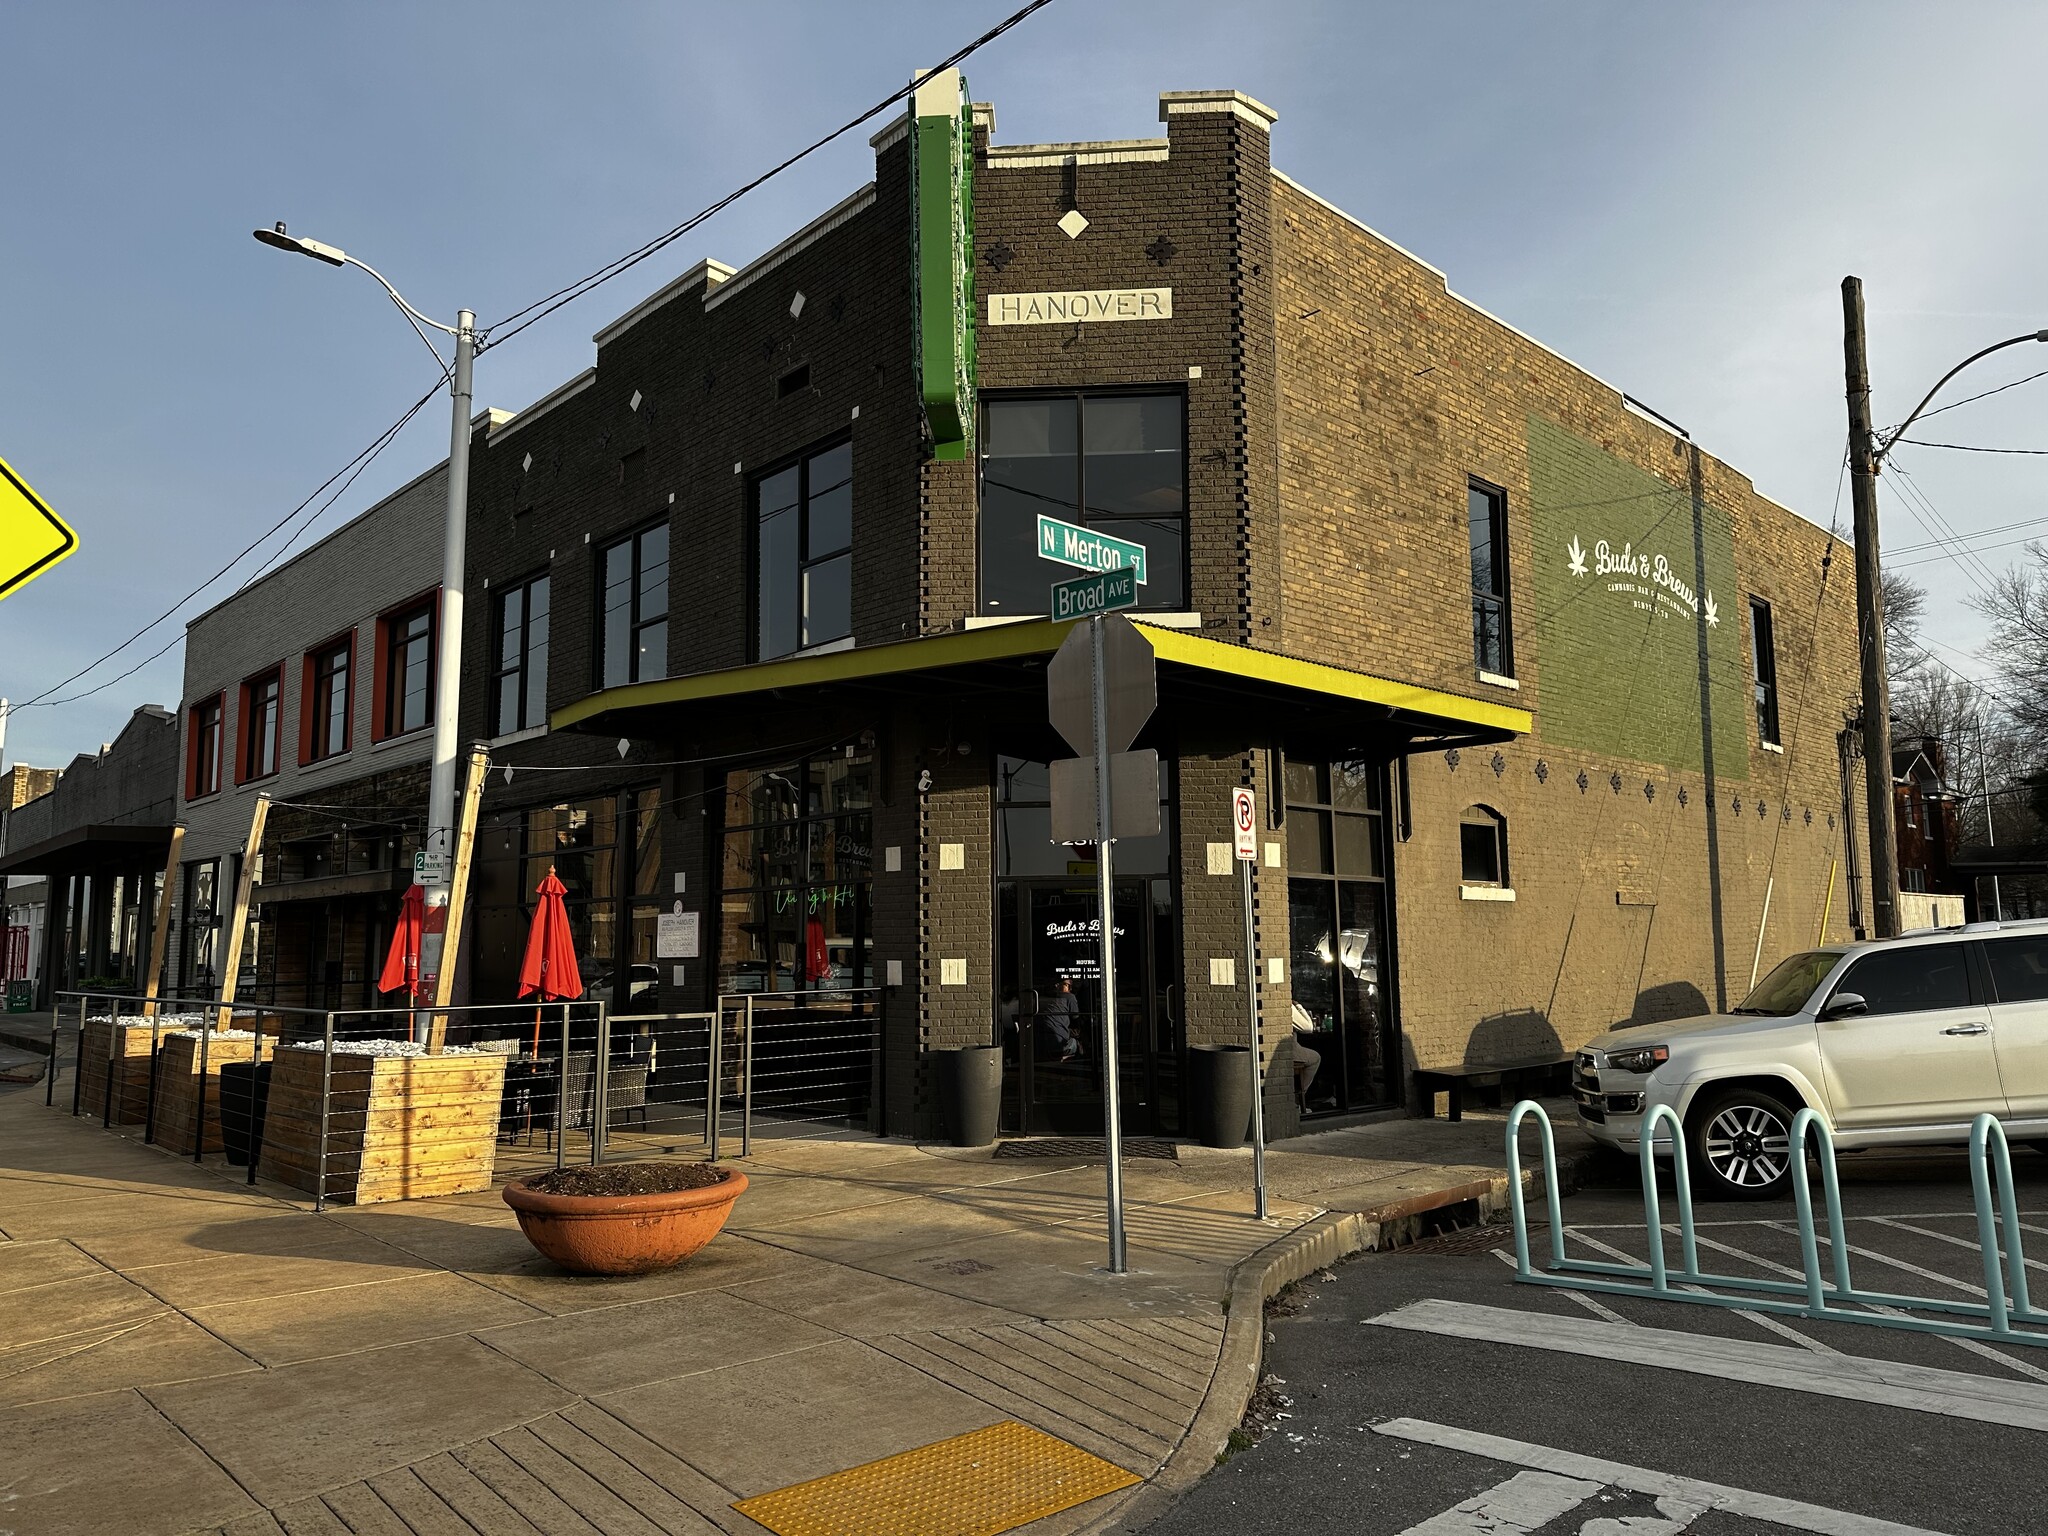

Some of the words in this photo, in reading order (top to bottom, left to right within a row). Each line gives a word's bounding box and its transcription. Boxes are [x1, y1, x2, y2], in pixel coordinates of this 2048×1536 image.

[1001, 292, 1163, 321] HANOVER
[1043, 524, 1055, 552] N
[1064, 528, 1121, 570] Merton
[1595, 540, 1638, 576] Buds
[1639, 553, 1650, 579] &
[1653, 554, 1699, 613] Brews
[1059, 578, 1105, 616] Broad
[1108, 579, 1130, 598] AVE
[417, 856, 424, 869] 2
[1046, 920, 1077, 936] Buds
[1078, 922, 1087, 931] &
